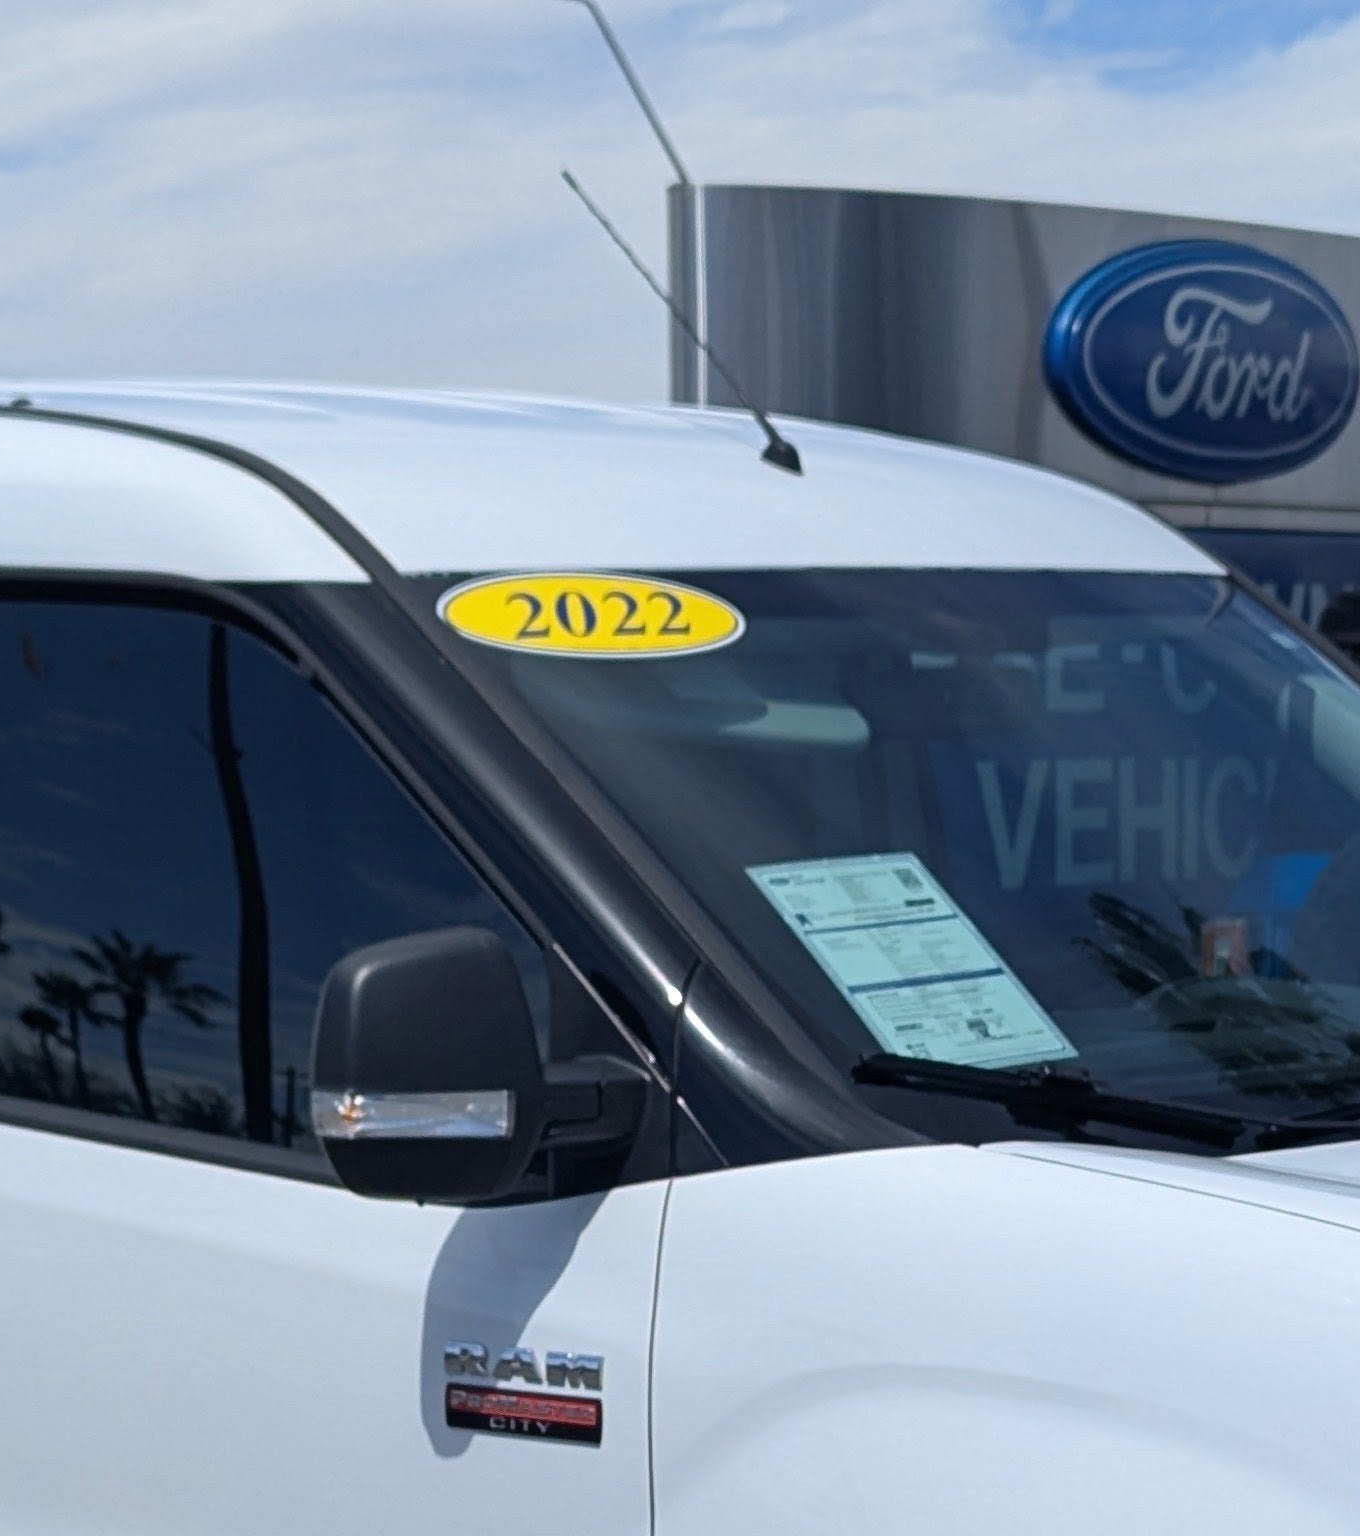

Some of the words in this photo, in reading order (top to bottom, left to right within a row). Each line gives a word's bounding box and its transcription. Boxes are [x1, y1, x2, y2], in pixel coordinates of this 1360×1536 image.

[1145, 286, 1313, 423] Ford
[505, 590, 691, 640] 2022
[443, 1340, 605, 1391] RAM
[488, 1415, 551, 1435] CITY
